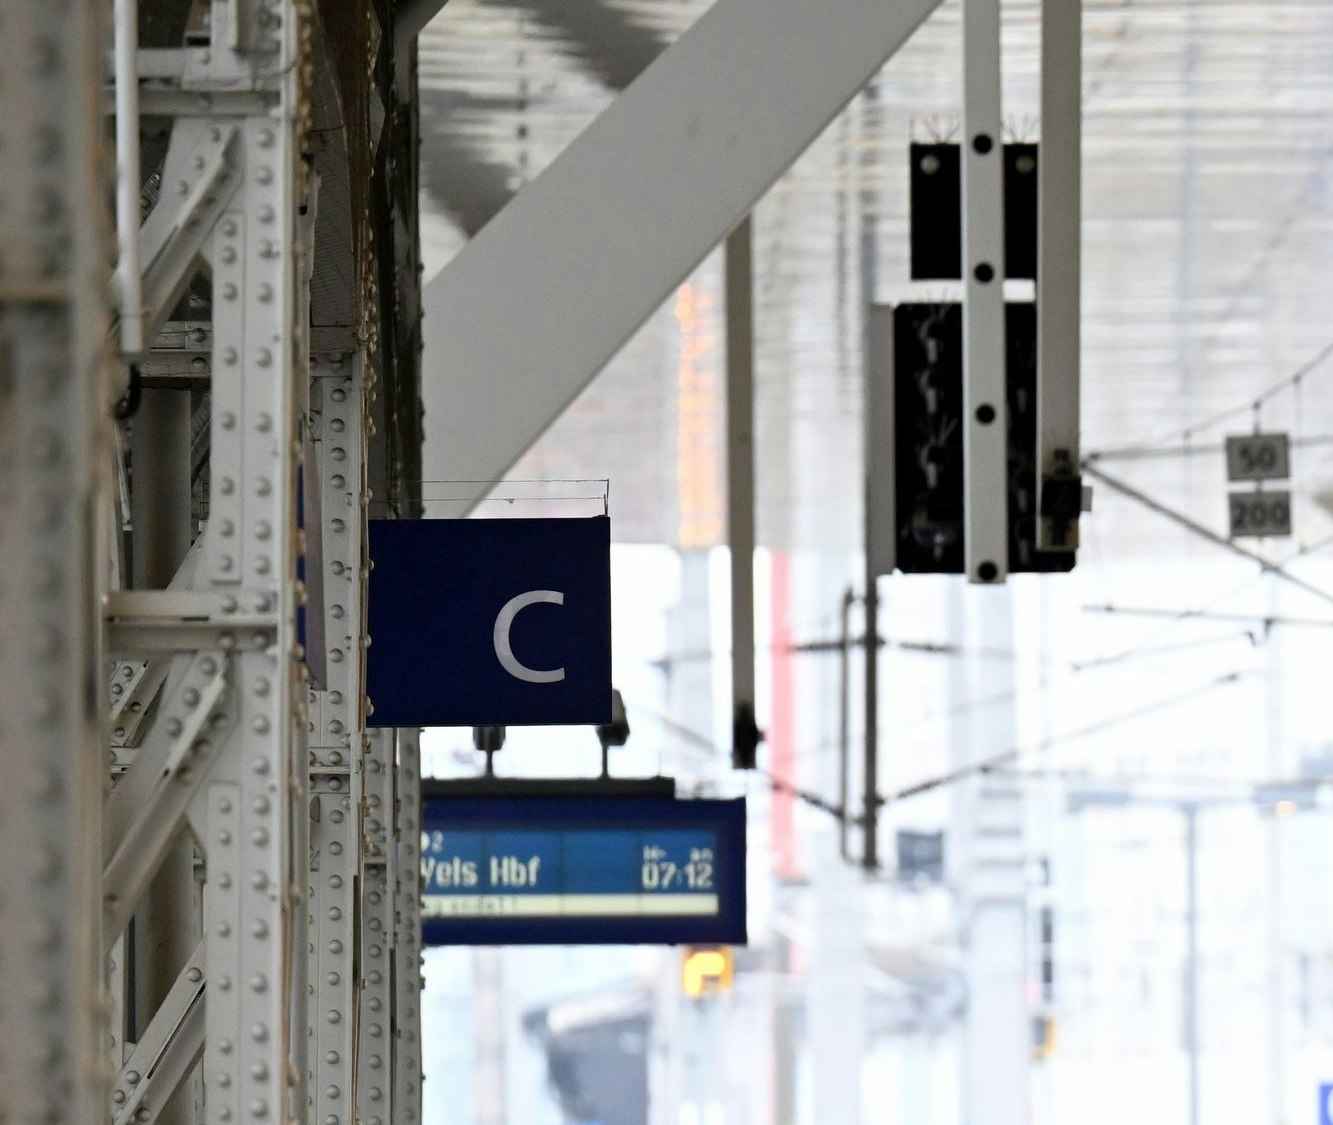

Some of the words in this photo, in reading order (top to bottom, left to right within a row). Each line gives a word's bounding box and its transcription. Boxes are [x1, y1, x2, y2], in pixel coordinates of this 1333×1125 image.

[493, 589, 566, 684] C
[489, 856, 541, 888] Hbf
[641, 861, 713, 890] 07:12
